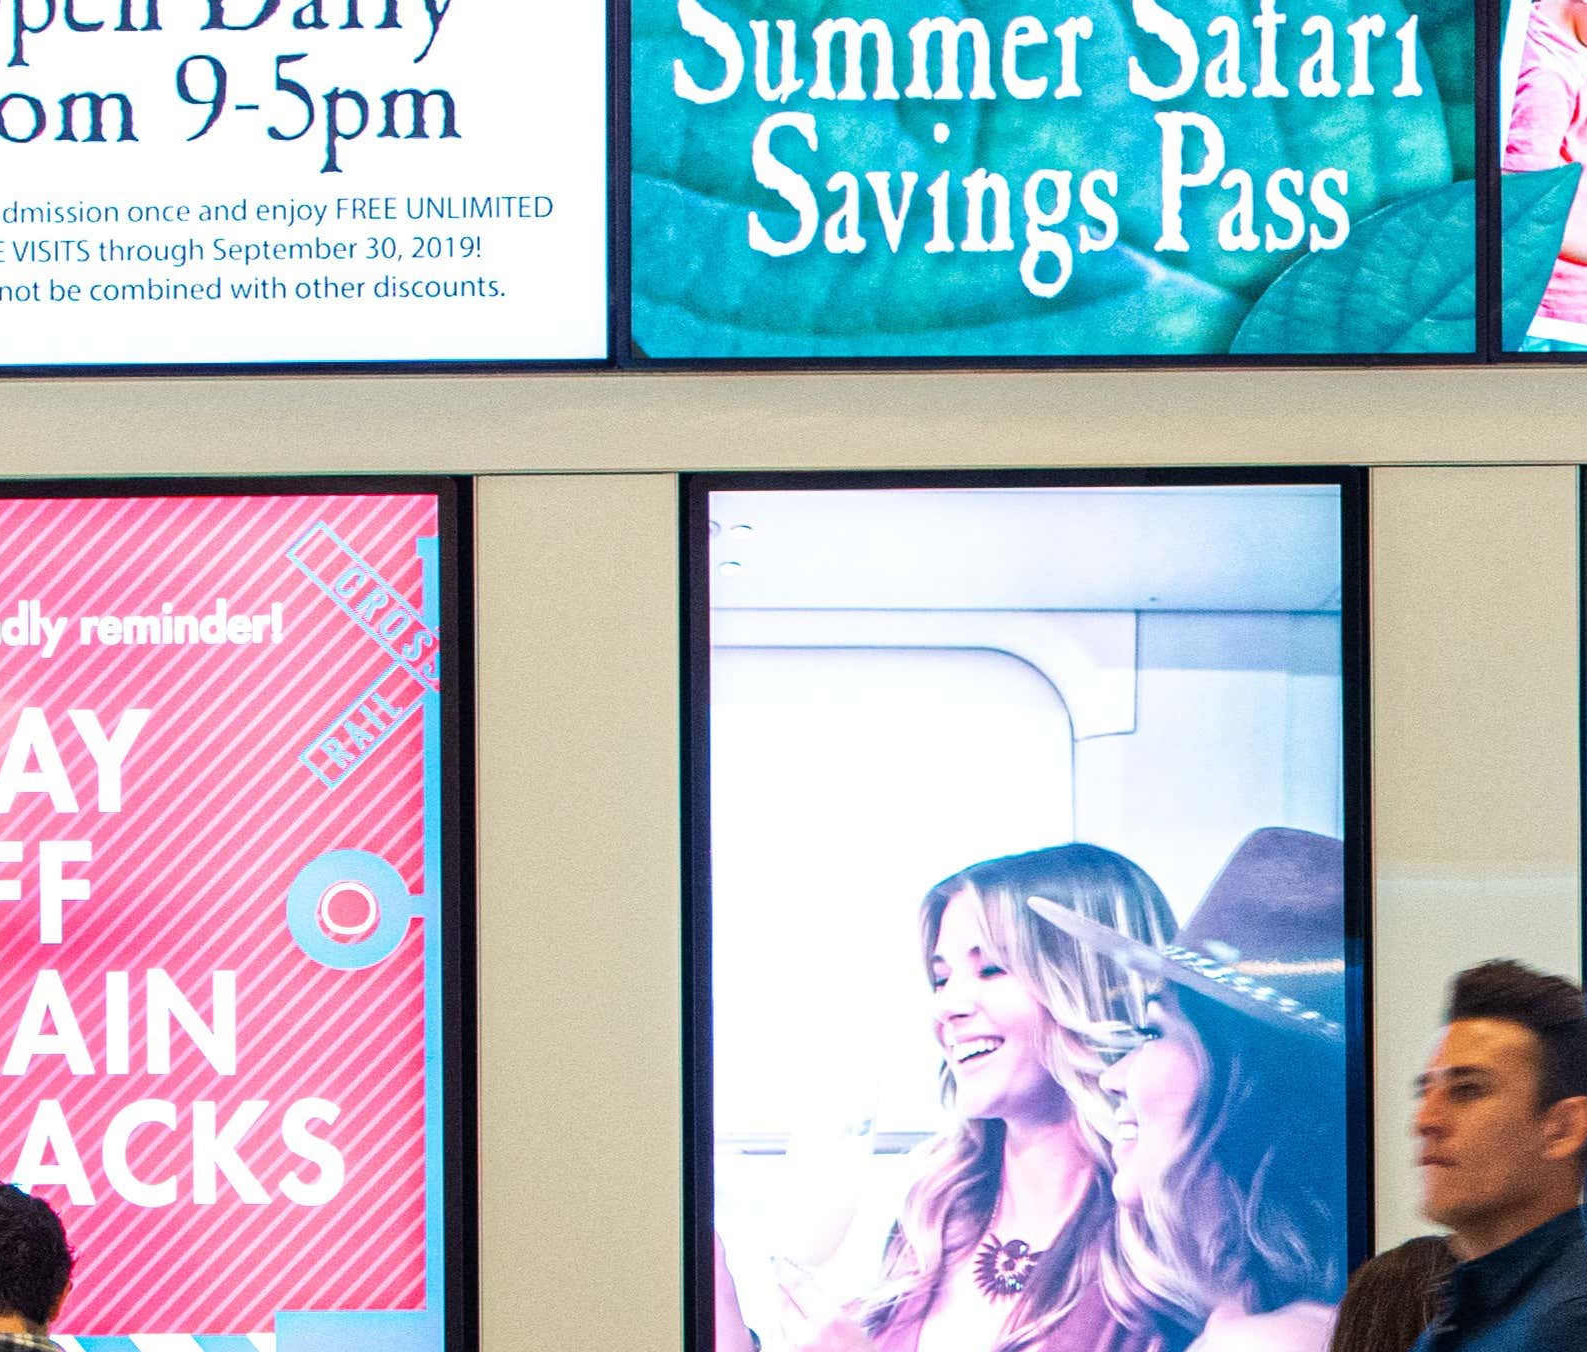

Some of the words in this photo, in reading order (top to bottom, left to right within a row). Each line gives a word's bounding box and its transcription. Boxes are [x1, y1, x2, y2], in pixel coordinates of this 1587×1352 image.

[672, 0, 1095, 103] Summer
[1128, 0, 1425, 103] Safari
[175, 53, 462, 174] 9-5pm
[128, 206, 190, 222] once
[199, 199, 246, 221] and
[257, 201, 327, 226] enjoy
[337, 198, 397, 219] FREE
[407, 196, 553, 219] UNLIMITED
[746, 111, 1120, 299] Savings
[1153, 111, 1352, 254] Pass
[13, 240, 89, 262] VISITS
[99, 239, 203, 267] through
[214, 237, 357, 265] September
[366, 237, 402, 261] 30,
[412, 236, 480, 258] 2019!
[50, 279, 81, 301] be
[90, 277, 221, 301] combined
[231, 277, 286, 299] with
[296, 276, 365, 299] other
[374, 275, 505, 297] discounts.
[80, 598, 283, 646] reminder!
[320, 691, 403, 770] RAIL
